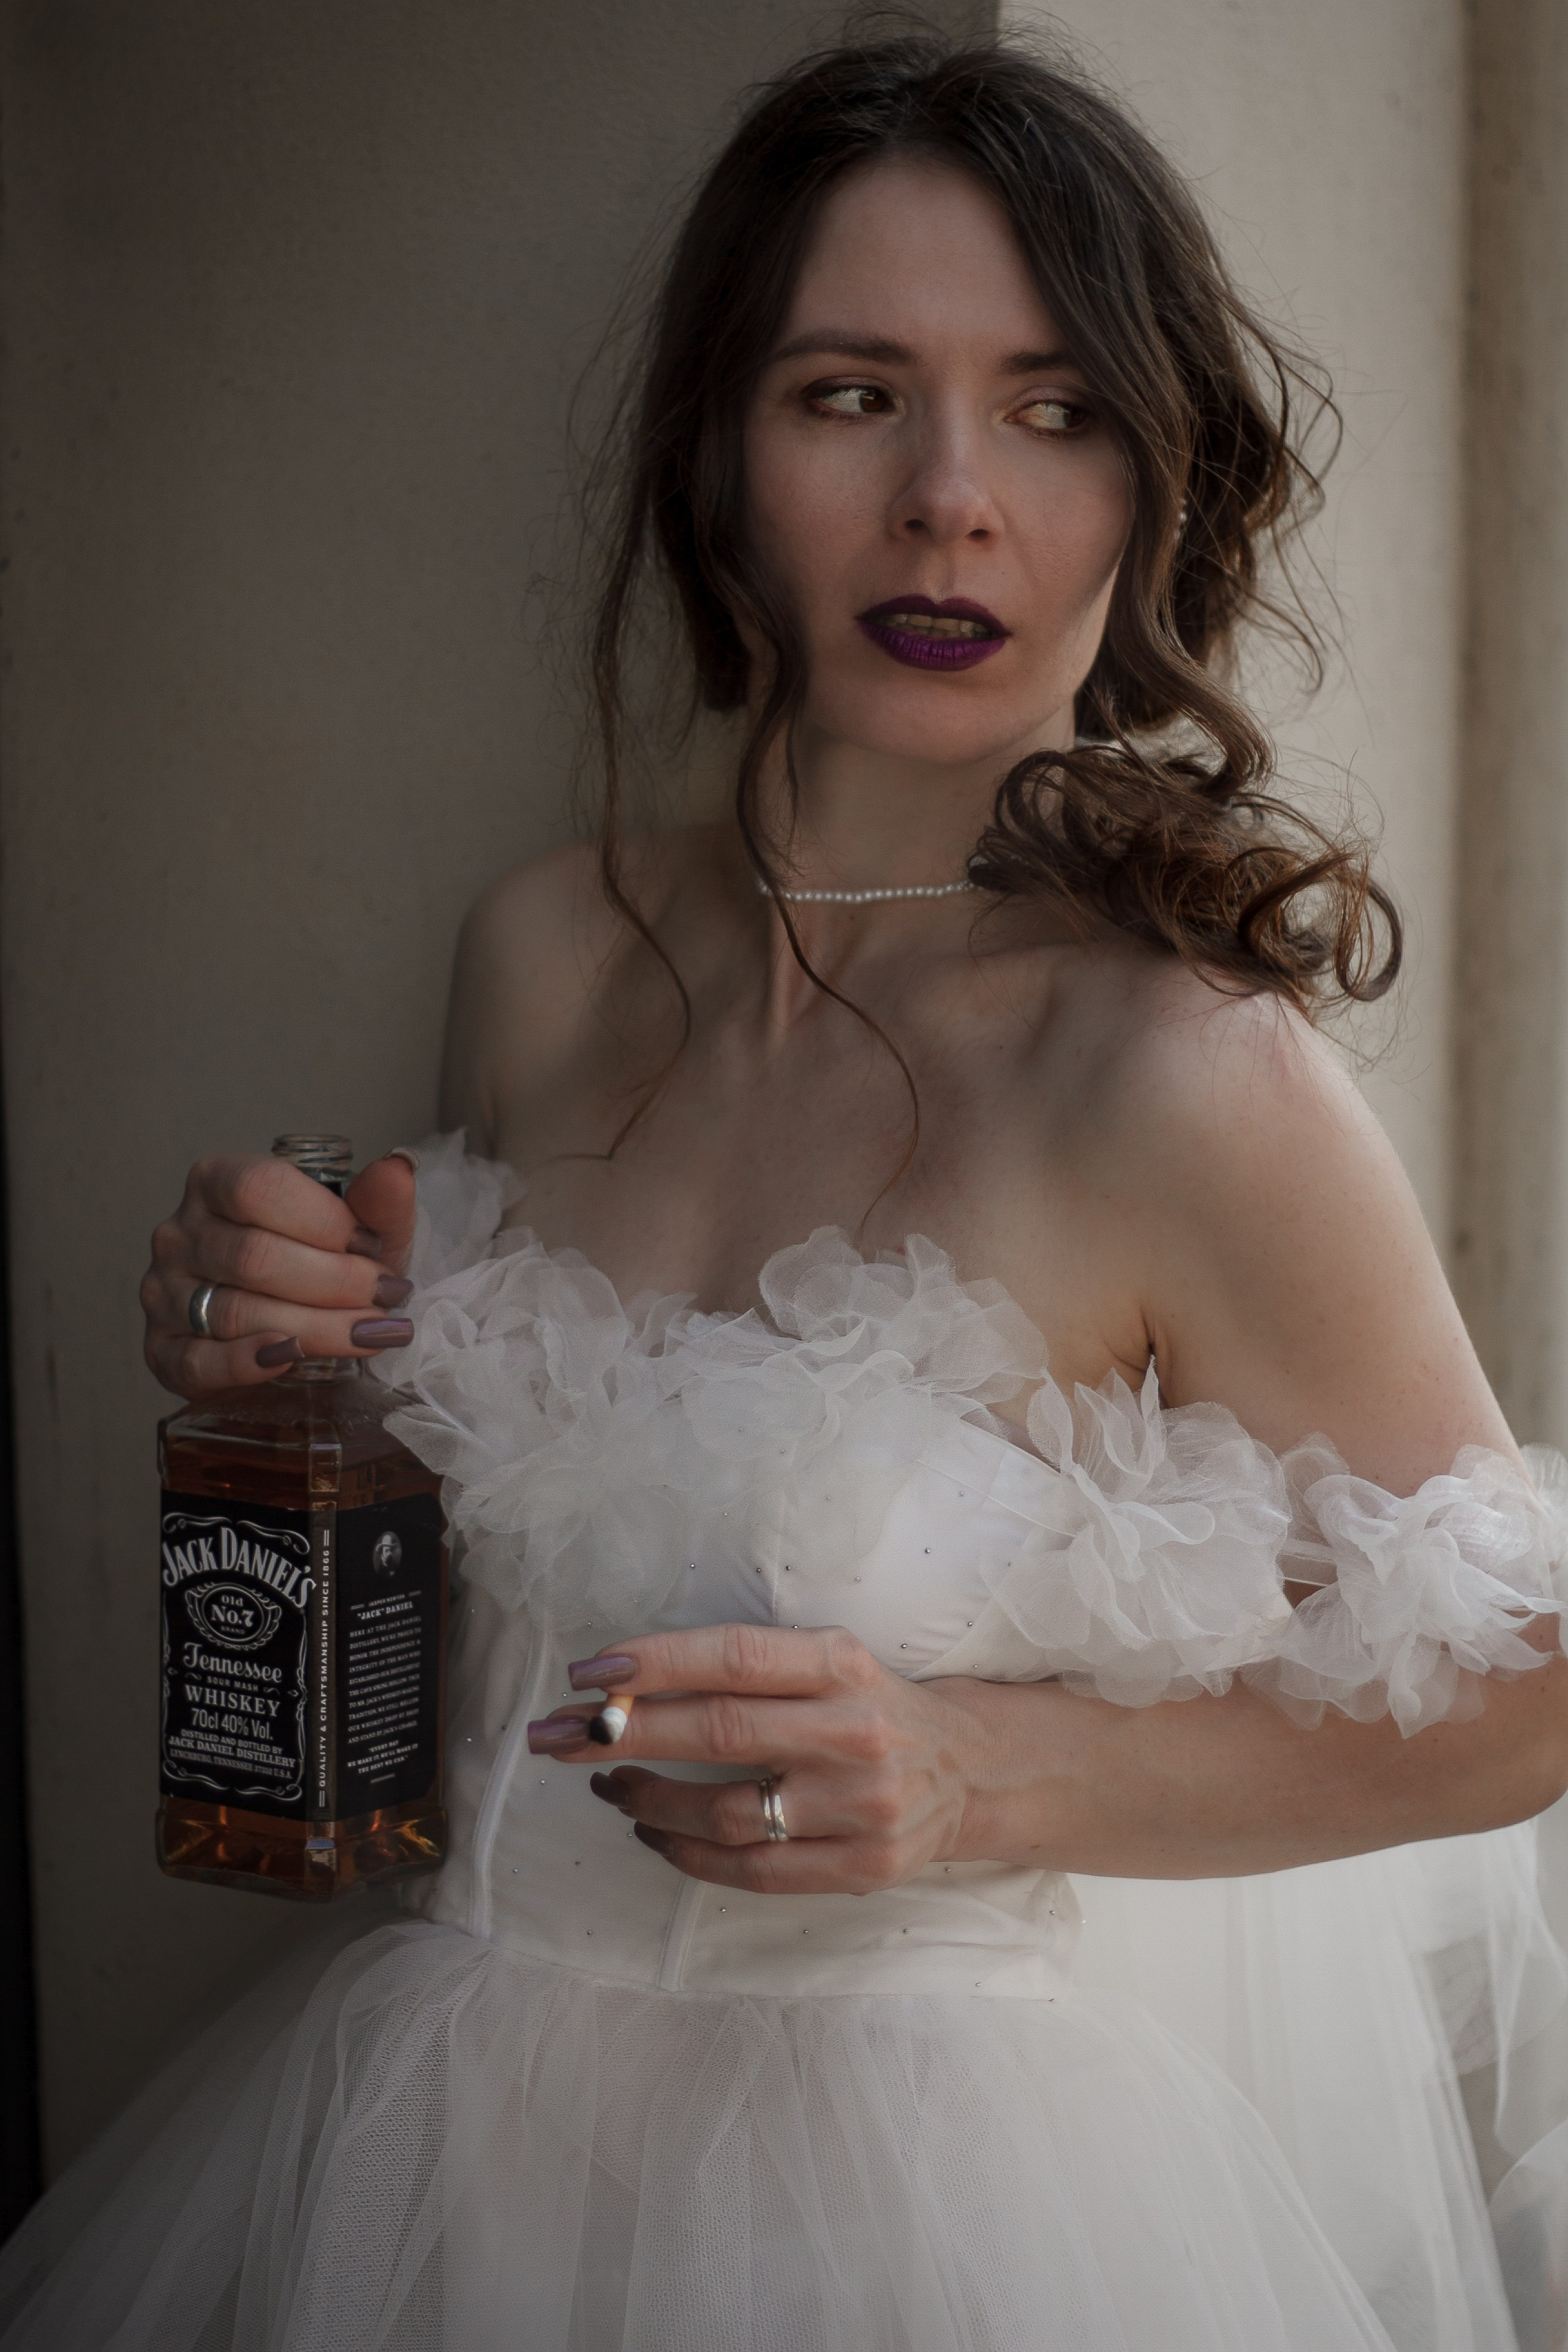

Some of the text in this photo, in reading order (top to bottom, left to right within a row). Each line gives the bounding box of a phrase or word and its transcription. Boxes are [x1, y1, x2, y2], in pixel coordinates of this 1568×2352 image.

[162, 1526, 317, 1608] JACK DANIEL'S
[321, 1580, 330, 1616] SINCE
[386, 1601, 413, 1613] DANIEL
[183, 1642, 282, 1683] Tennessee
[320, 1620, 329, 1722] CRAFTSMANSHIP
[184, 1684, 281, 1717] WHISKEY
[206, 1675, 259, 1692] SOUR MASK
[190, 1706, 273, 1741] 70cl 40% Vol.
[168, 1735, 296, 1768] JACK DANIEL DISTILLERY
[181, 1728, 284, 1755] DISTILLED AND BOTTLED BY
